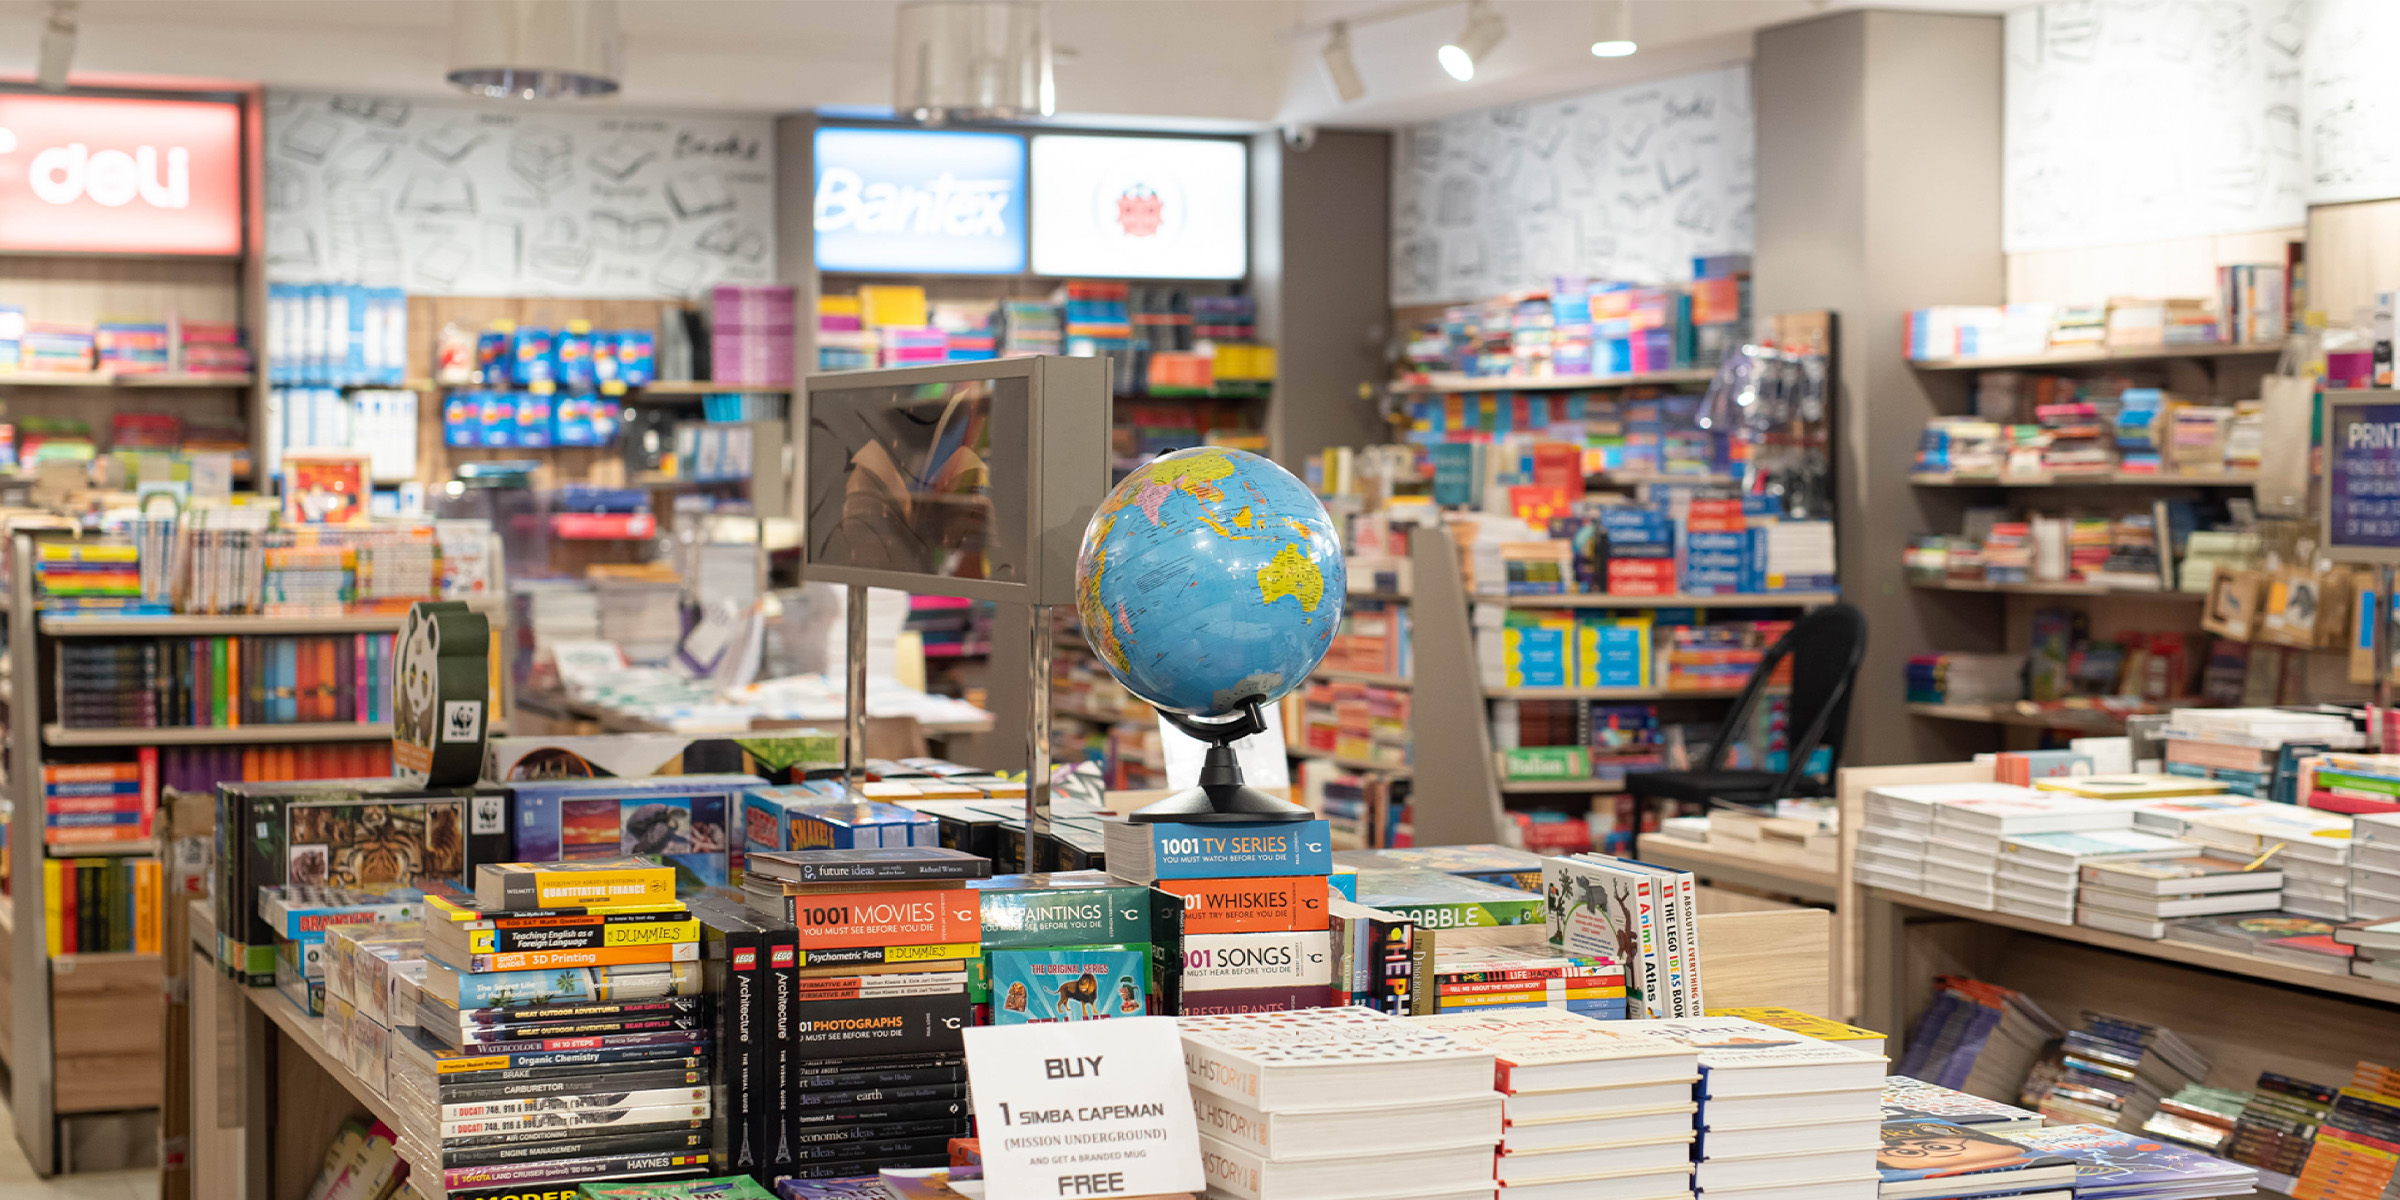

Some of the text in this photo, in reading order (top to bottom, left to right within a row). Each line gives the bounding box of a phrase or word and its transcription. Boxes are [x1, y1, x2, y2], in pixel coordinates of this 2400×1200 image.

[814, 167, 1011, 236] Bantex
[1161, 836, 1287, 855] 1001 TV SERIES
[1162, 856, 1179, 864] YOU
[1230, 854, 1256, 862] BEFORE
[819, 865, 850, 876] future
[851, 865, 876, 876] ideas
[919, 866, 942, 874] Richard
[542, 884, 646, 898] QUANTITATIVE FINANCE
[1185, 892, 1288, 910] 01 WHISKIES
[803, 907, 849, 926] 1001
[854, 903, 935, 924] MOVIES
[1019, 904, 1102, 922] PAINTINGS
[1185, 912, 1207, 920] MUST
[1209, 911, 1223, 919] TRY
[1256, 910, 1273, 918] YOU
[981, 920, 1102, 932] YOU SEE BEFORE YOU DIE
[1684, 895, 1695, 946] ABSOLUTELY
[512, 931, 547, 941] Teaching
[549, 930, 575, 939] English
[616, 928, 680, 942] DUMMIES
[804, 923, 934, 936] YOU MUST SEE BEFORE YOU DIE
[517, 938, 588, 948] Foreign Language
[532, 953, 595, 965] 3D Printing
[735, 954, 755, 964] LEGO
[773, 952, 793, 961] LEGO
[808, 950, 882, 963] Psychometric Tests
[896, 946, 946, 958] DUMMIES
[1217, 946, 1291, 967] SONGS
[1639, 903, 1657, 1002] Animal Atlas
[1664, 902, 1684, 1018] THE LEGO IDEAS BOOK
[1030, 964, 1109, 974] THE ORIGINAL SERIES
[1187, 969, 1207, 977] MUST
[1210, 968, 1229, 976] HEAR
[1232, 967, 1259, 975] BEFORE
[1261, 966, 1278, 974] YOU
[1510, 968, 1559, 979] LIFE HACKS
[1688, 947, 1699, 999] EVERYTHING
[542, 1009, 574, 1017] OUTDOOR
[575, 1006, 620, 1015] ADVENTURES
[624, 1004, 642, 1012] BEAR
[737, 975, 751, 1042] Architecture
[775, 972, 789, 1039] Architecture
[542, 1026, 574, 1035] OUTDOOR
[575, 1024, 621, 1033] ADVENTURES
[643, 1020, 671, 1028] GRYLLS
[813, 1016, 903, 1031] PHOTOGRAPHS
[805, 1029, 903, 1041] MUST SEE BEFORE YOU DIE
[478, 1042, 542, 1053] WATERCOLOUR
[572, 1039, 594, 1047] STEPS
[518, 1053, 552, 1066] Organic
[554, 1052, 600, 1065] Chemistry
[503, 1070, 530, 1078] BRAKE
[1044, 1056, 1104, 1080] BUY
[1199, 1058, 1243, 1089] HISTORY
[504, 1082, 564, 1094] CARBURETTOR
[811, 1075, 835, 1087] ideas
[856, 1088, 883, 1101] earth
[999, 1102, 1164, 1126] 1 SIMBA CAPEMAN
[1207, 1104, 1252, 1139] HISTORY
[506, 1131, 568, 1142] AIR CONDITIONING
[1004, 1127, 1168, 1151] (MISSION UNDERGROUND)
[500, 1149, 528, 1158] ENGINE
[529, 1145, 581, 1156] MANAGEMENT
[811, 1146, 835, 1158] ideas
[1029, 1156, 1049, 1165] AND
[1051, 1155, 1069, 1164] GET
[1078, 1152, 1122, 1163] BRANDED
[1124, 1150, 1147, 1159] MUG
[462, 1174, 491, 1183] TOYOTA
[492, 1171, 511, 1180] LAND
[513, 1169, 544, 1179] CRUISER
[545, 1167, 569, 1177] (petrol)
[627, 1157, 669, 1170] HAYNES
[810, 1167, 835, 1177] ideas
[1057, 1172, 1125, 1196] FREE
